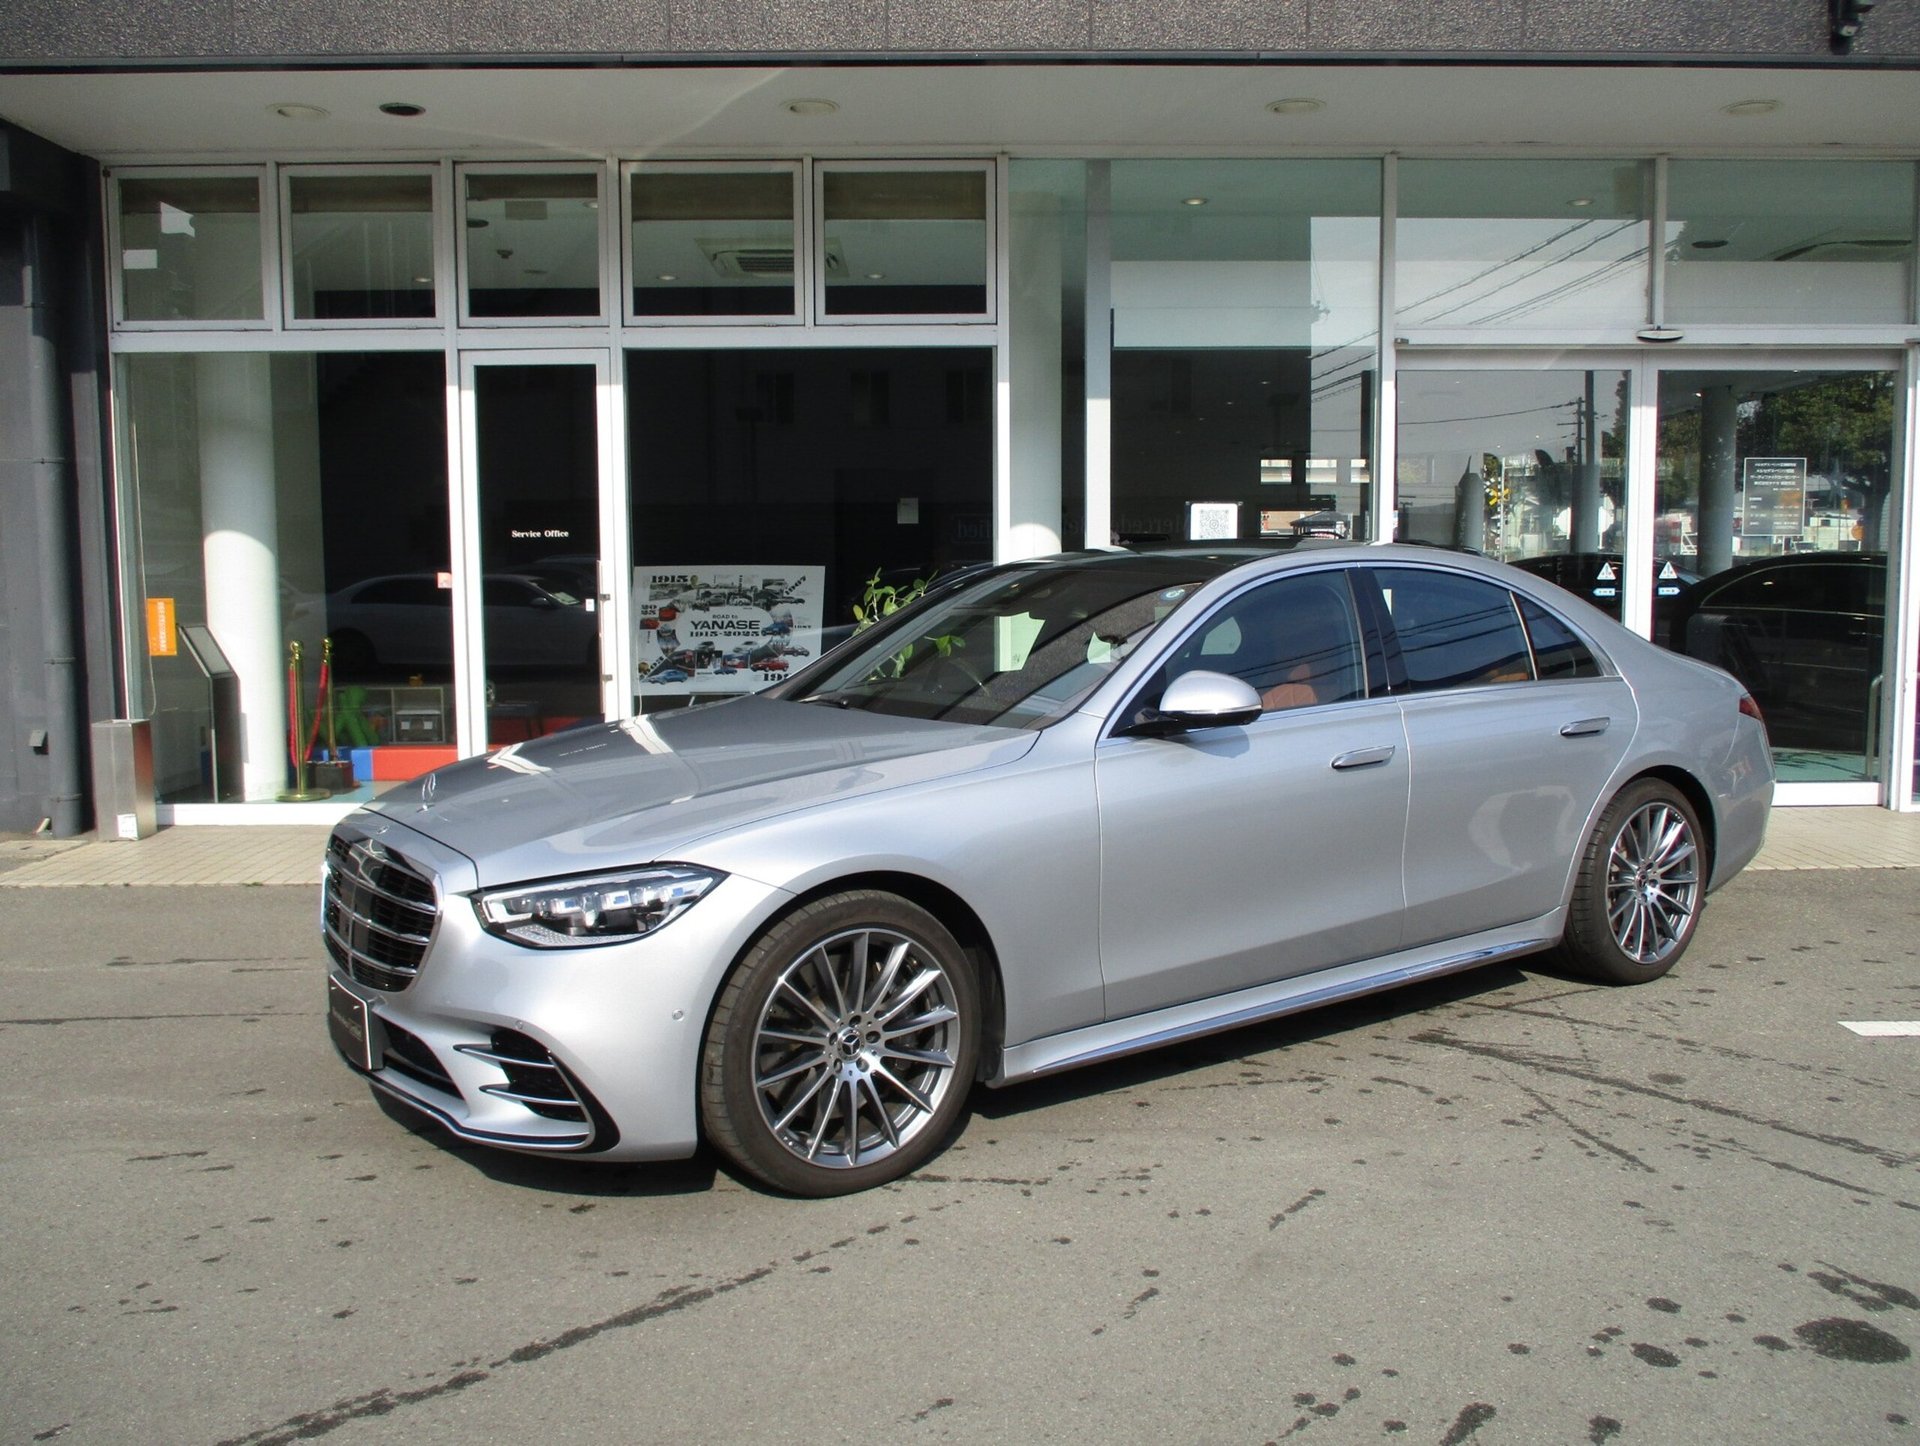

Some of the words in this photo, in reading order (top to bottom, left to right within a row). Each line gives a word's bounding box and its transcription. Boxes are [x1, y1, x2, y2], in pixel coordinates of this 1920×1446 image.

[511, 529, 542, 538] Service
[543, 529, 570, 538] Office
[651, 575, 689, 583] 1915
[690, 620, 761, 630] YANASE
